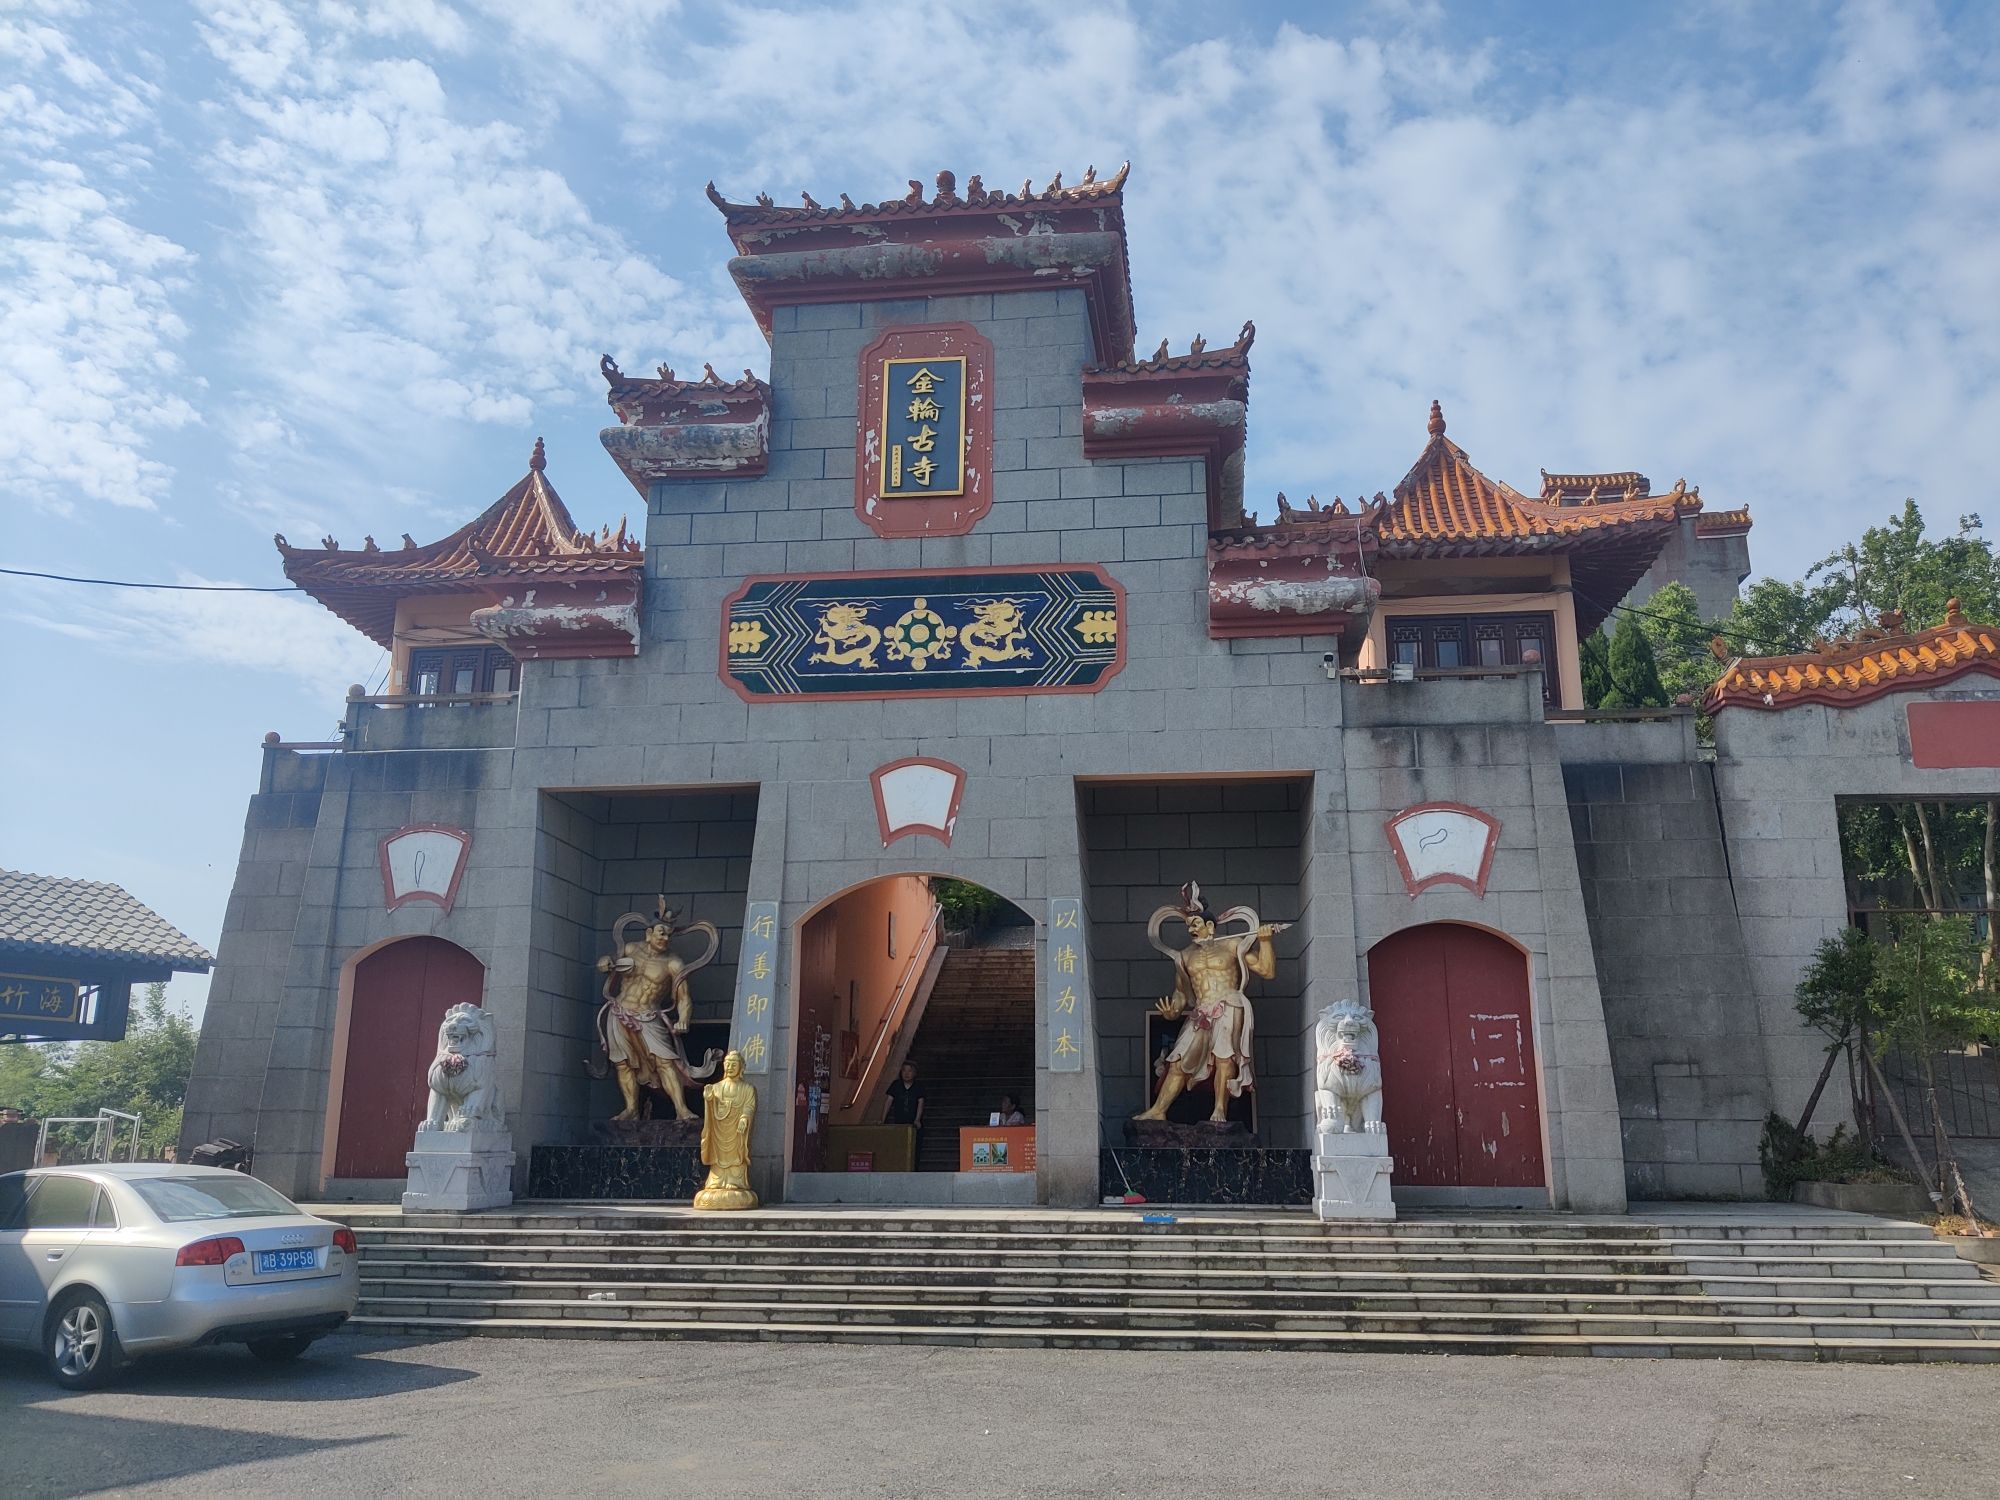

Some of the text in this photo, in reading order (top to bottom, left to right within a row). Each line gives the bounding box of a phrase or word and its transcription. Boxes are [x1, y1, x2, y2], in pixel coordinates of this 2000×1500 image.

[906, 367, 944, 486] 金輪古寺
[742, 914, 774, 1064] 行善即佛
[1053, 909, 1079, 1058] 以情为本
